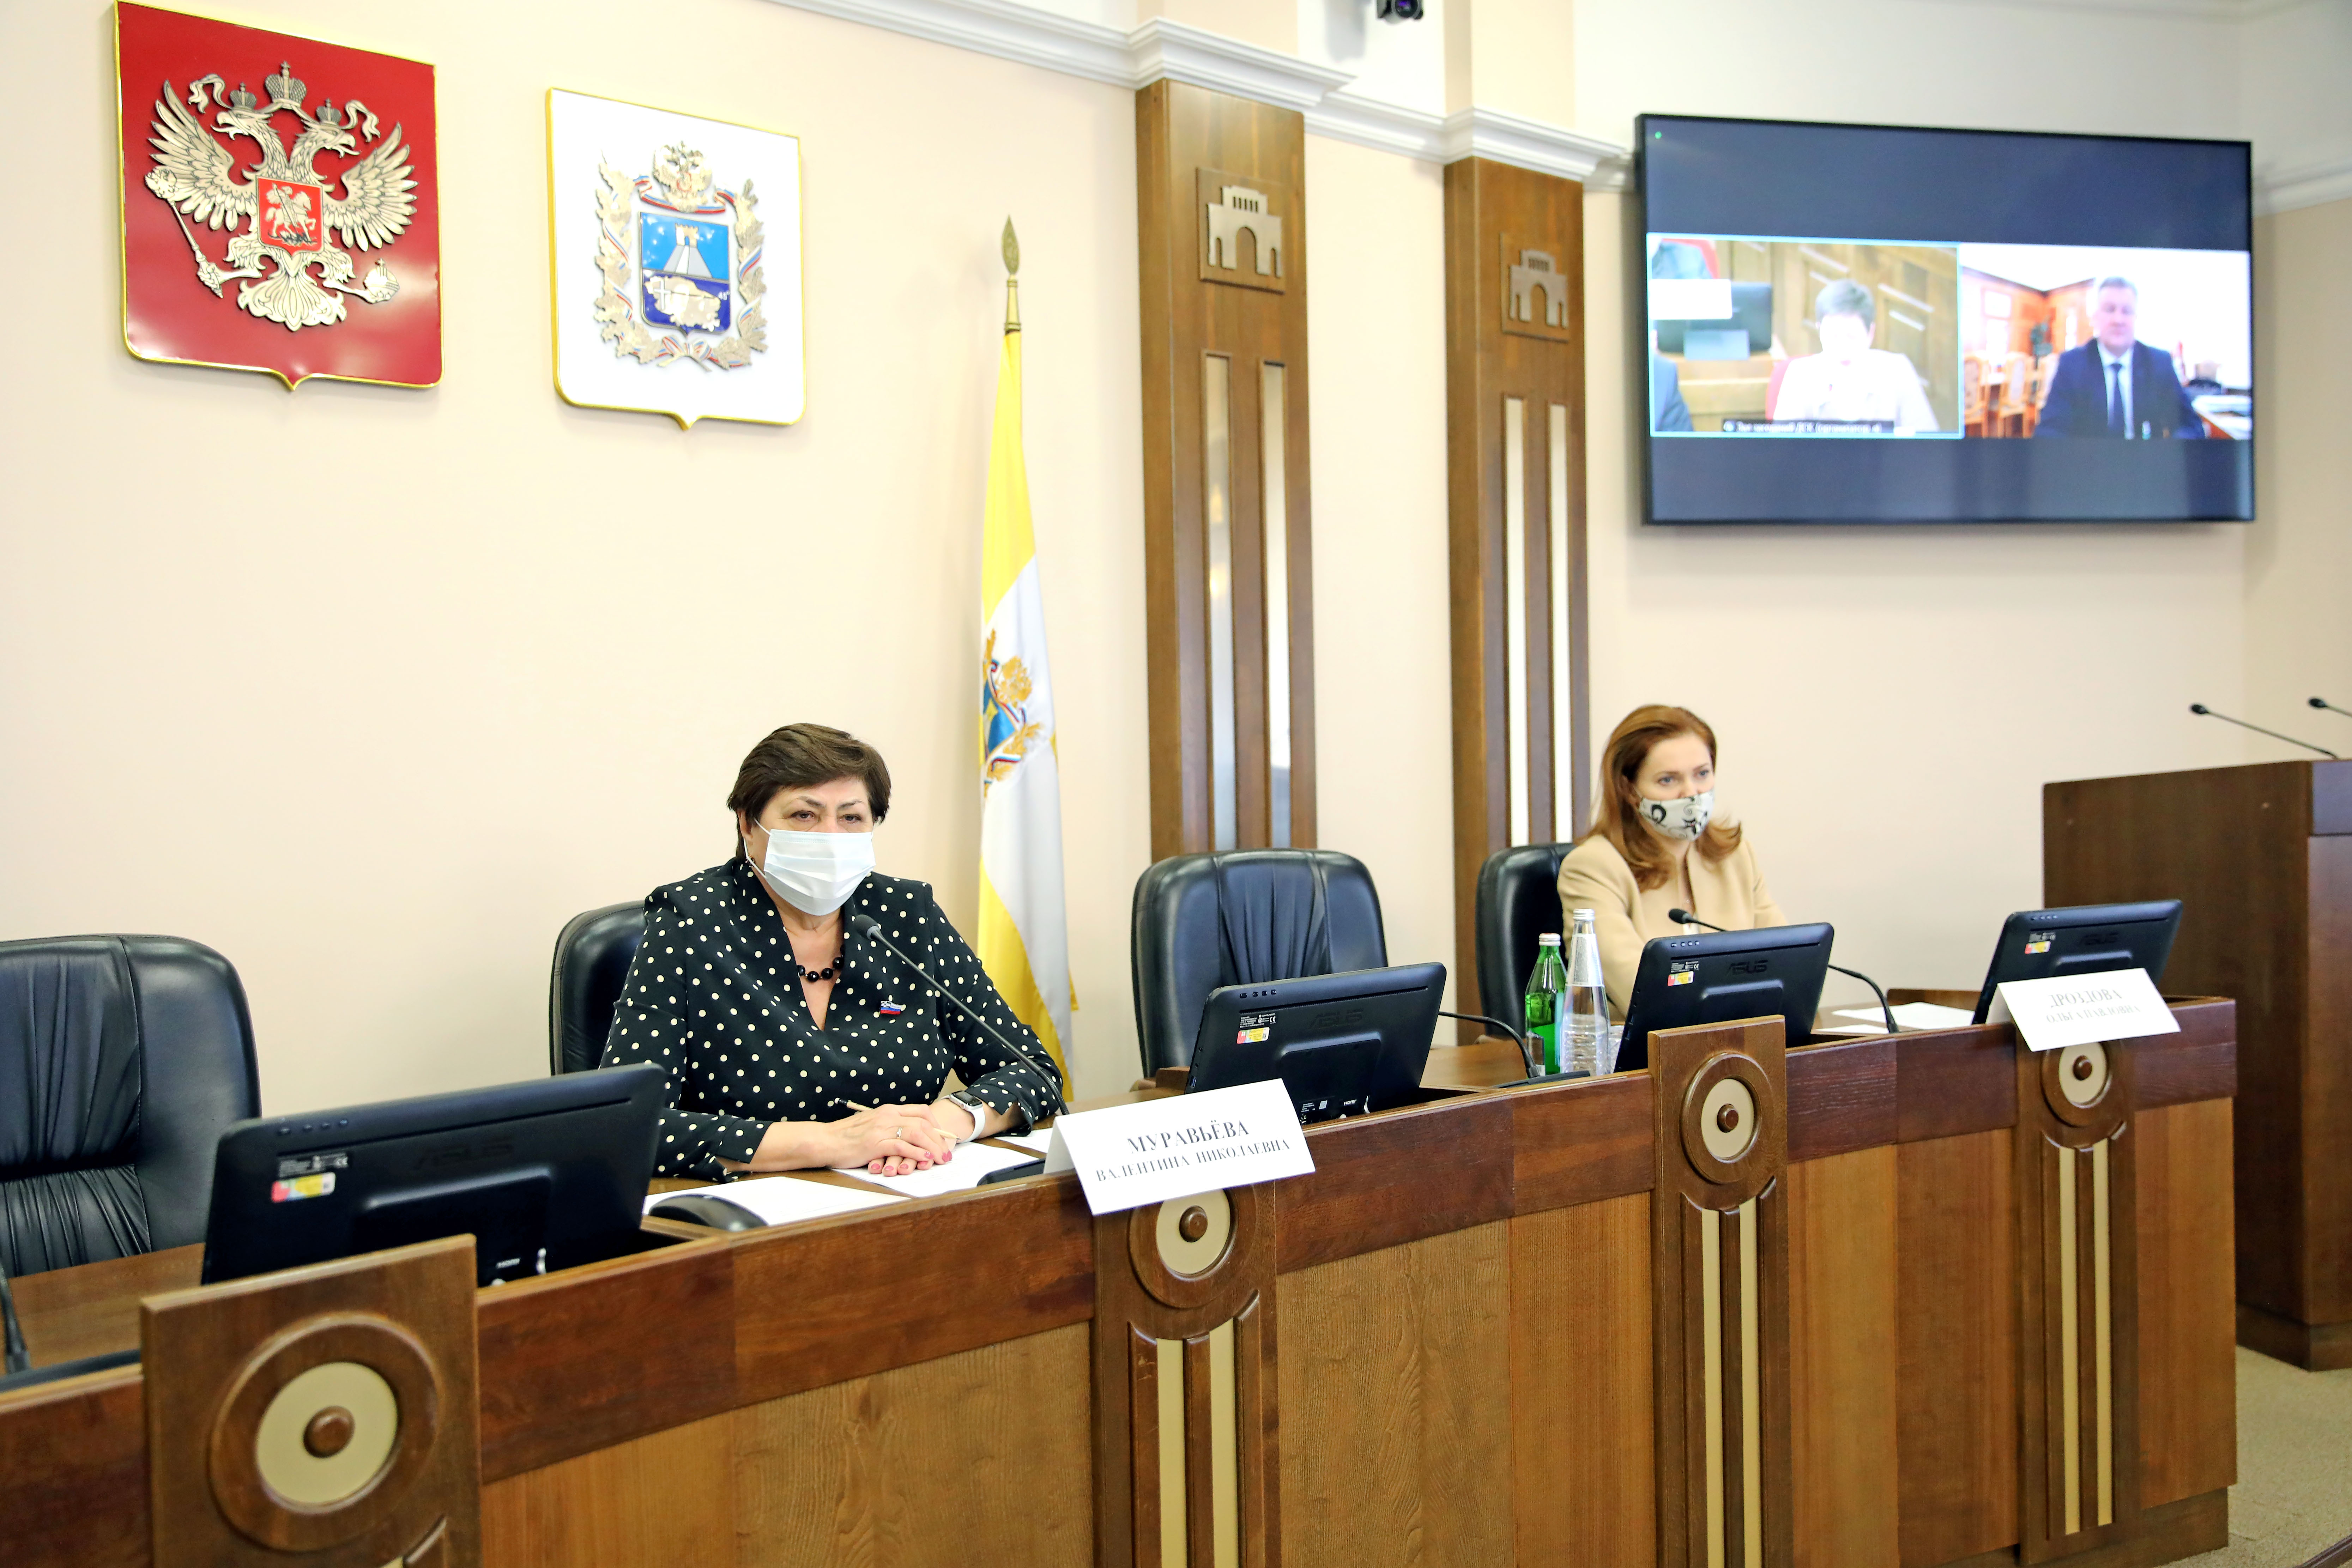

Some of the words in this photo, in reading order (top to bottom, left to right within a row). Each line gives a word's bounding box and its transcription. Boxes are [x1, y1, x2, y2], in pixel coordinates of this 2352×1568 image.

[1726, 959, 1768, 975] ASUS
[2049, 989, 2122, 1008] ДРОЗДОВА
[2046, 1011, 2084, 1023] ОЛЬГА
[1127, 1120, 1250, 1154] МУРАВЬЁВА
[1096, 1155, 1190, 1181] ВАЛЕНТИНА
[1196, 1139, 1290, 1163] НИКОЛАЕВНА
